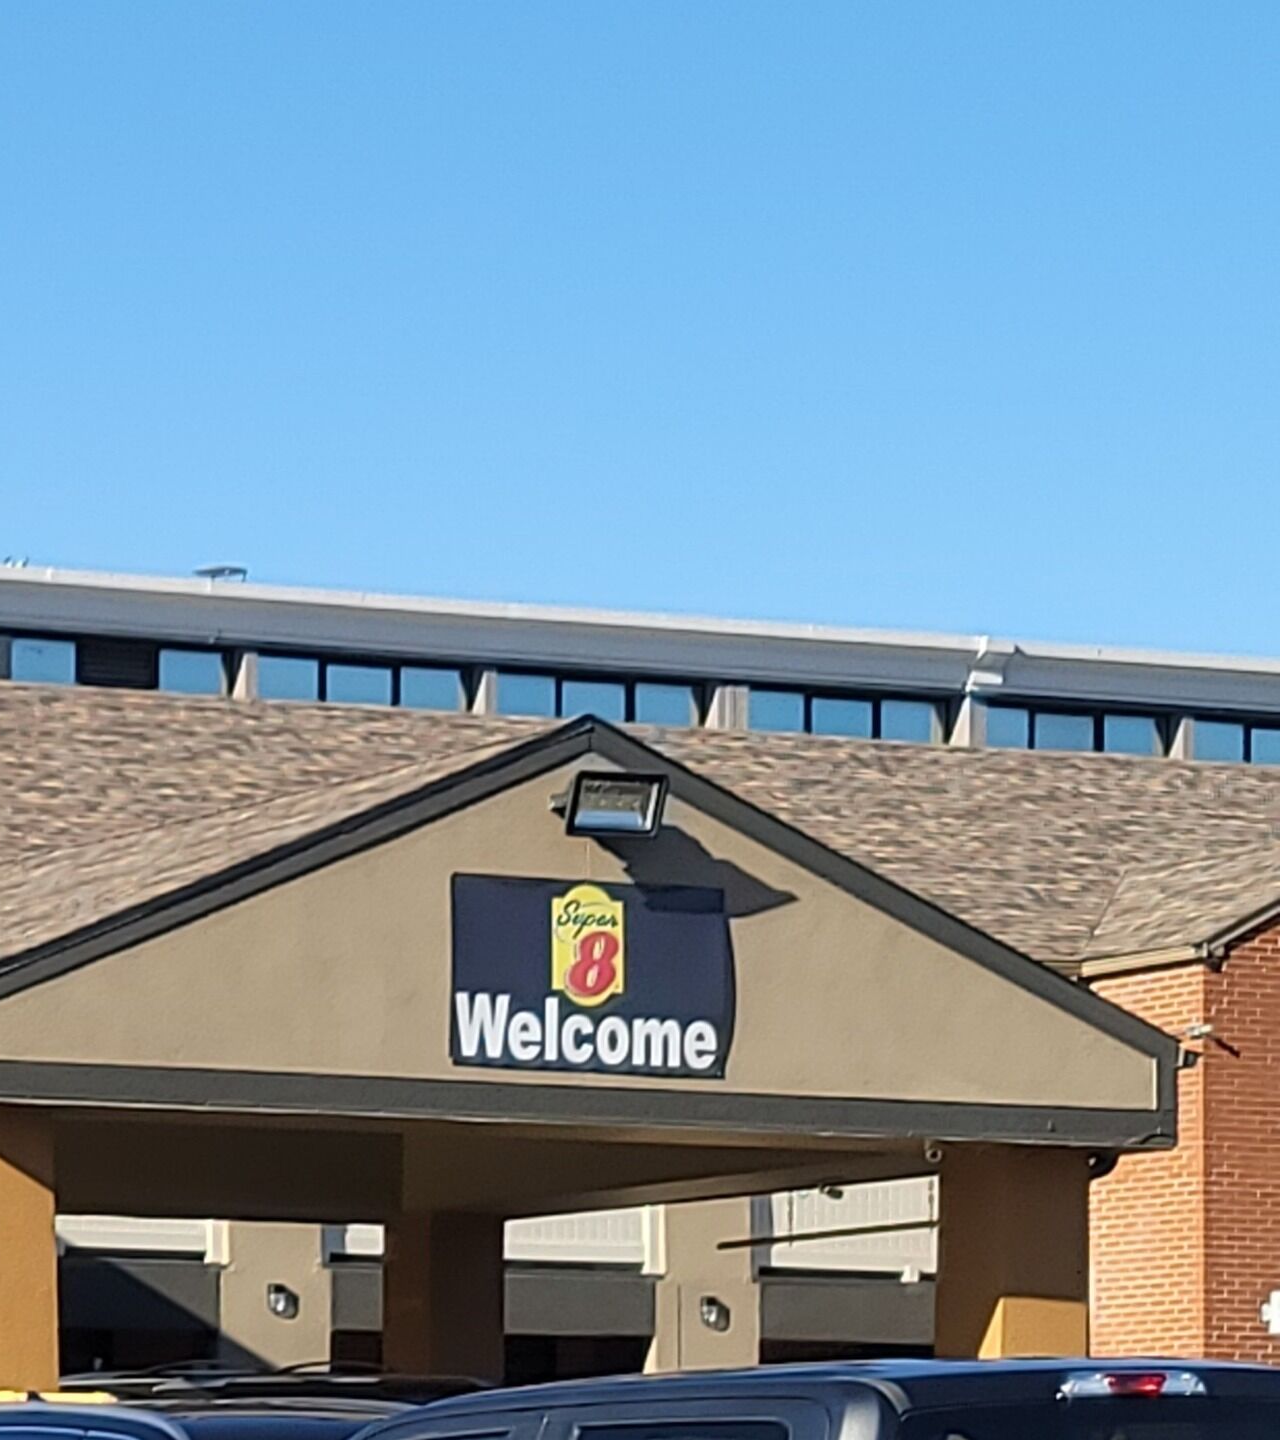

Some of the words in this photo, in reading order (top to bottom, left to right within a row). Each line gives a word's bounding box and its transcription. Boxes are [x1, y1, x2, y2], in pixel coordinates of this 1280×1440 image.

[556, 899, 619, 940] Super
[565, 931, 620, 998] 8
[455, 991, 718, 1070] Welcome
